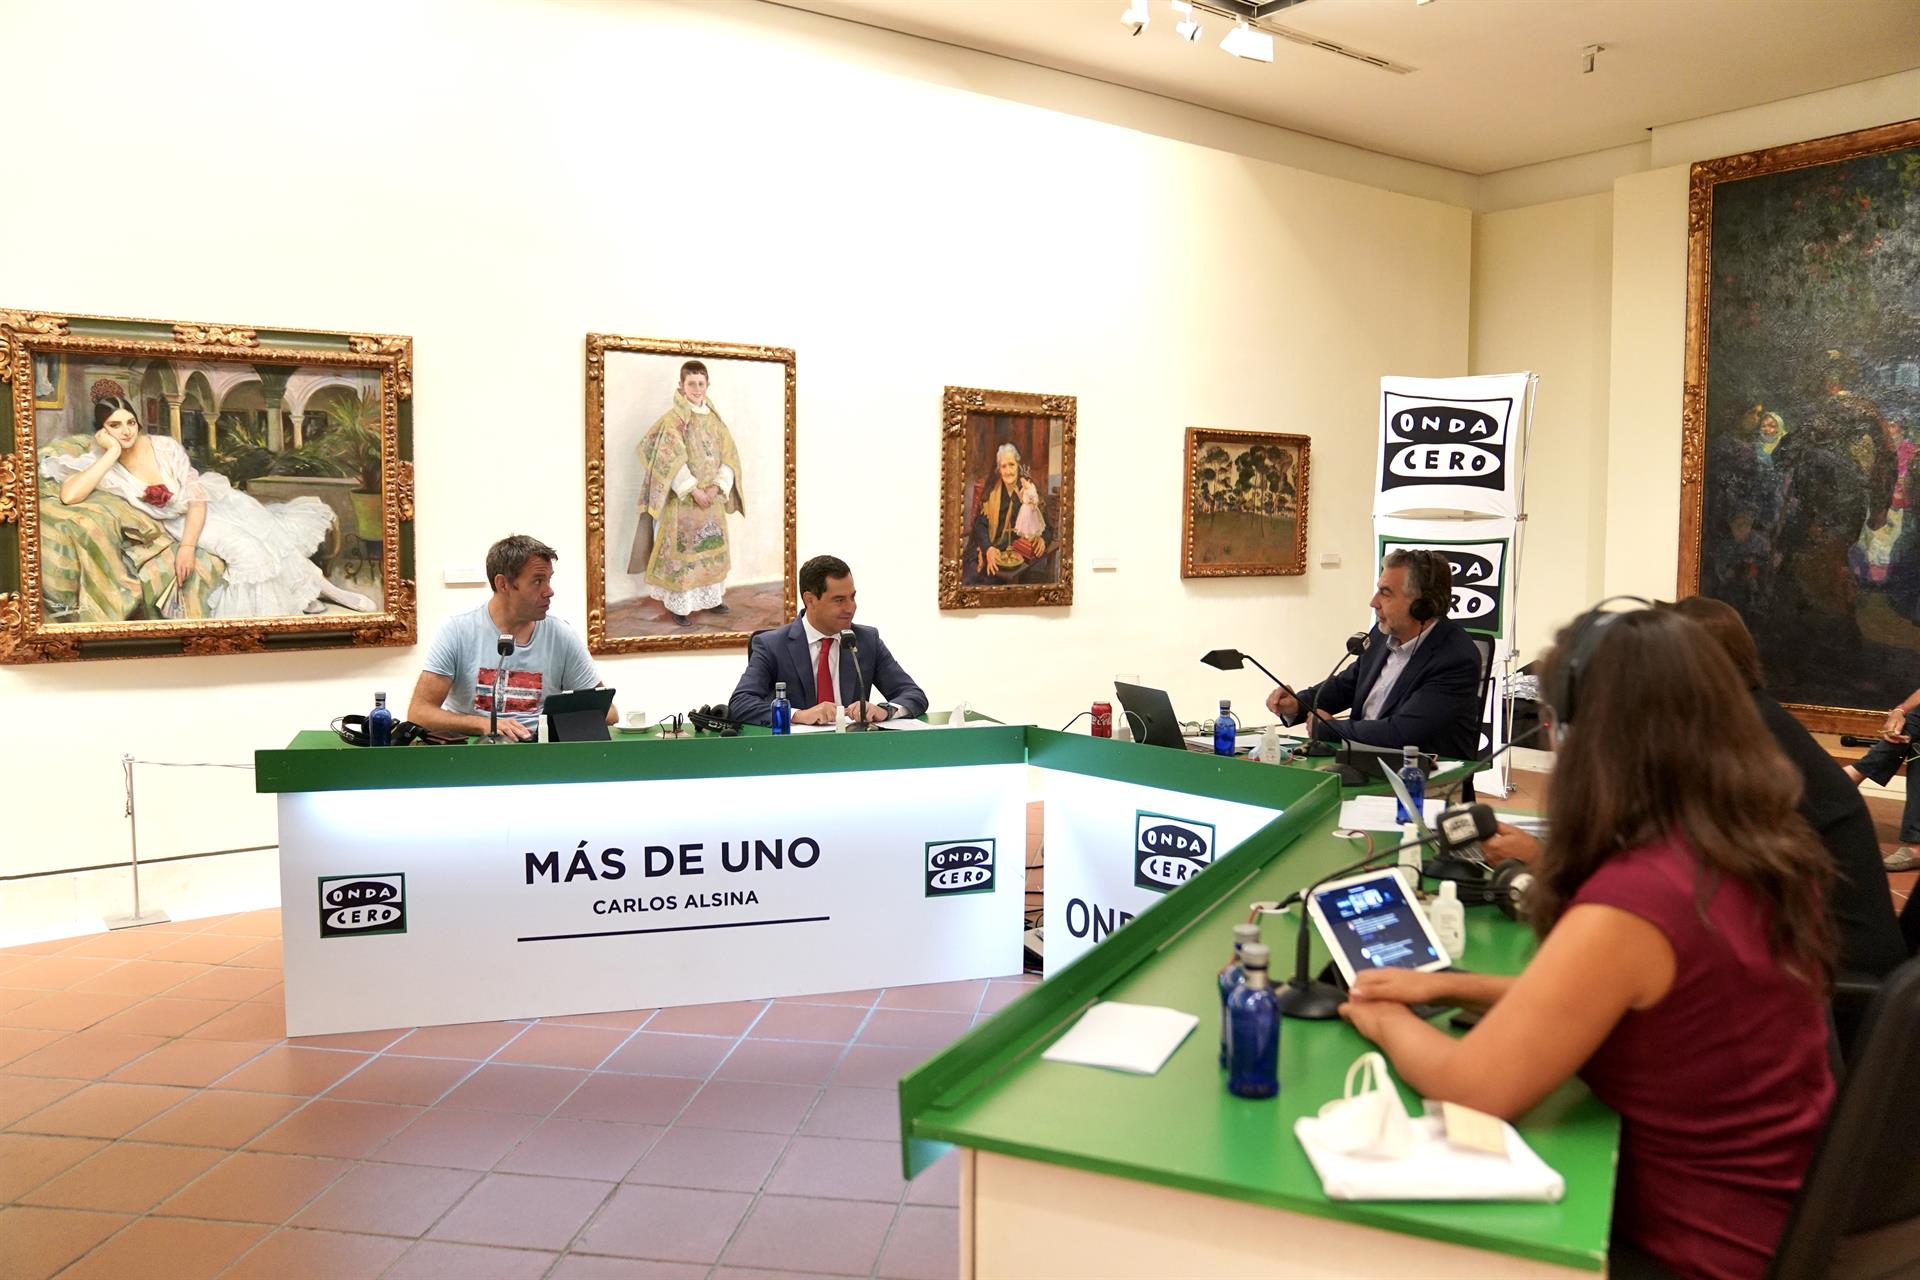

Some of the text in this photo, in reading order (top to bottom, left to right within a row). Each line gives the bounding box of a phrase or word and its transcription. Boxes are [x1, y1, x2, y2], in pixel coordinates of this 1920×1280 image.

[1400, 413, 1487, 435] ONDA
[1404, 449, 1486, 472] CERO
[1448, 561, 1483, 577] DA
[1450, 594, 1482, 614] RO
[1147, 830, 1201, 853] ONDA
[525, 836, 821, 885] MÁS DE UNO
[936, 851, 984, 865] ONDA
[939, 870, 984, 885] CERO
[332, 887, 391, 902] ONDA
[592, 889, 760, 915] CARLOS ALSINA
[337, 909, 392, 925] CERO
